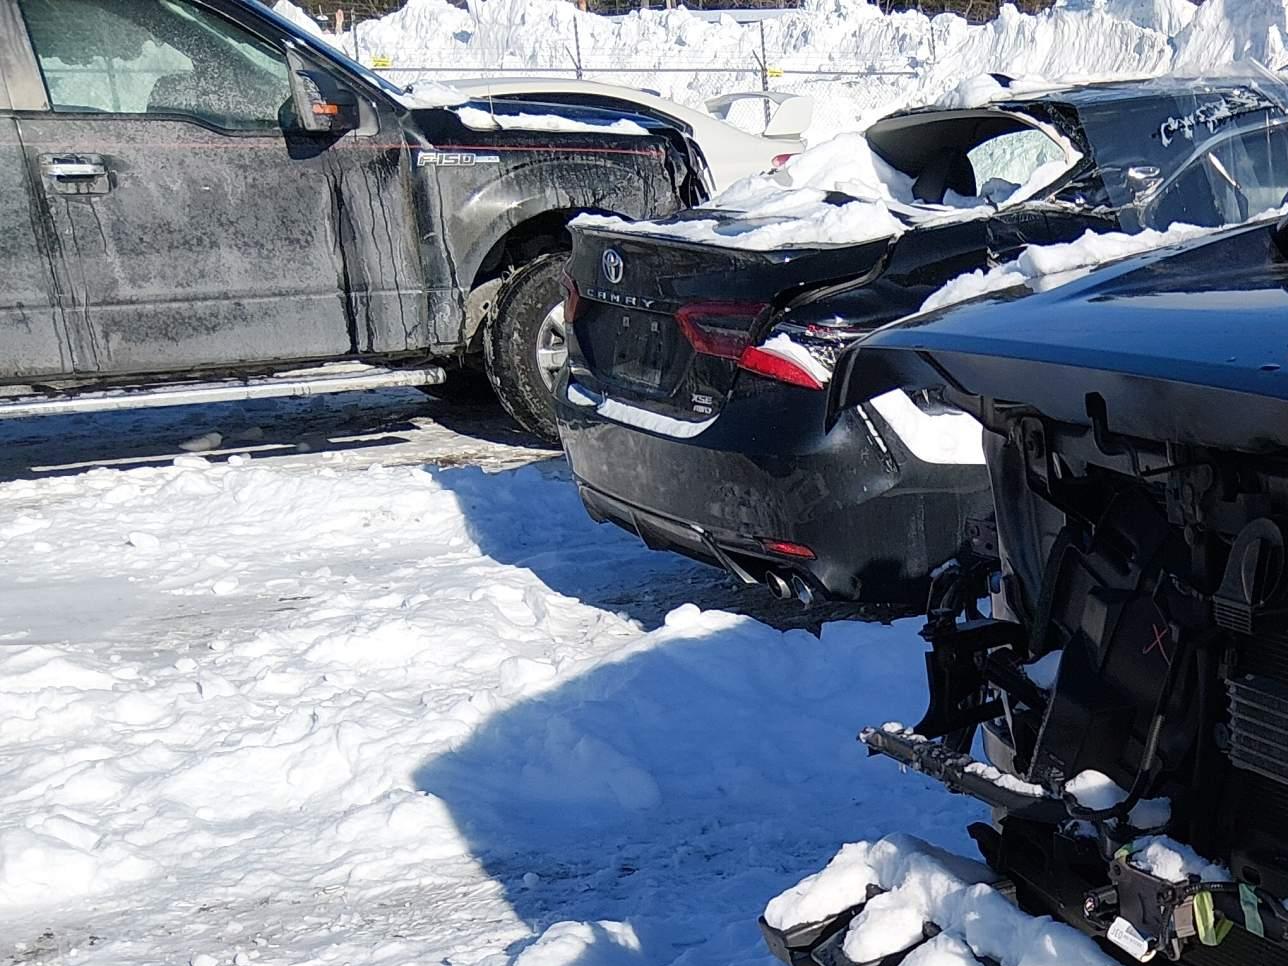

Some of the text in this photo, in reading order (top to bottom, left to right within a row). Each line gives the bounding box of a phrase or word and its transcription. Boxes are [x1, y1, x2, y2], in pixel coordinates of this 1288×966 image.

[417, 152, 476, 167] F-150
[586, 288, 656, 309] CAMRY
[691, 393, 713, 405] XSE
